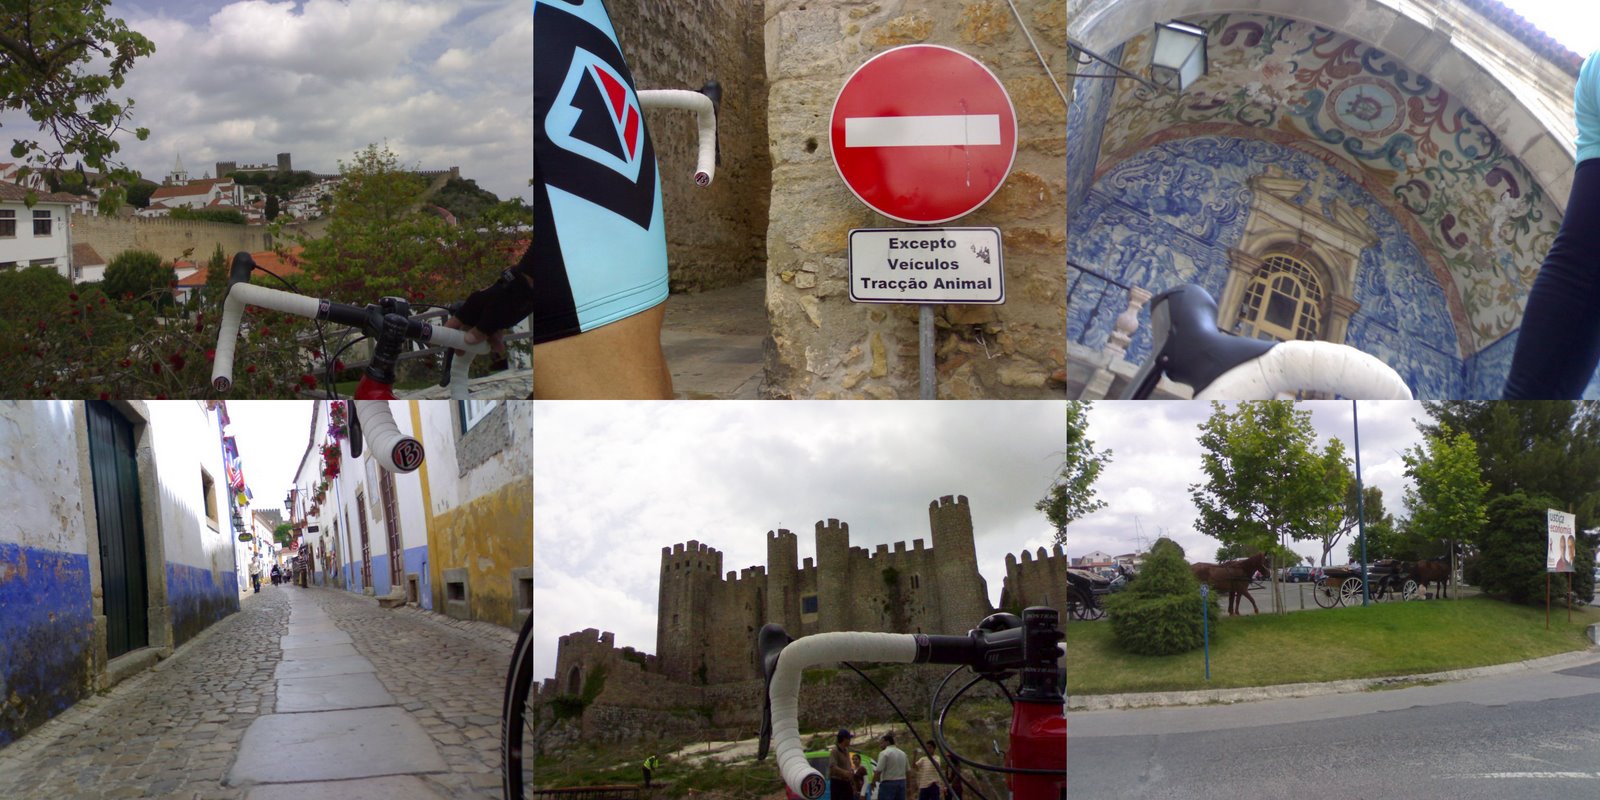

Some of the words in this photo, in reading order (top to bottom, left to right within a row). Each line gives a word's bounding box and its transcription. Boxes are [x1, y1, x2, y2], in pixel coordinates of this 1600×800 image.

[889, 237, 957, 251] Excepto
[887, 258, 960, 270] Veículos
[860, 277, 928, 292] Tracção
[933, 277, 992, 289] Animal
[398, 440, 422, 469] B
